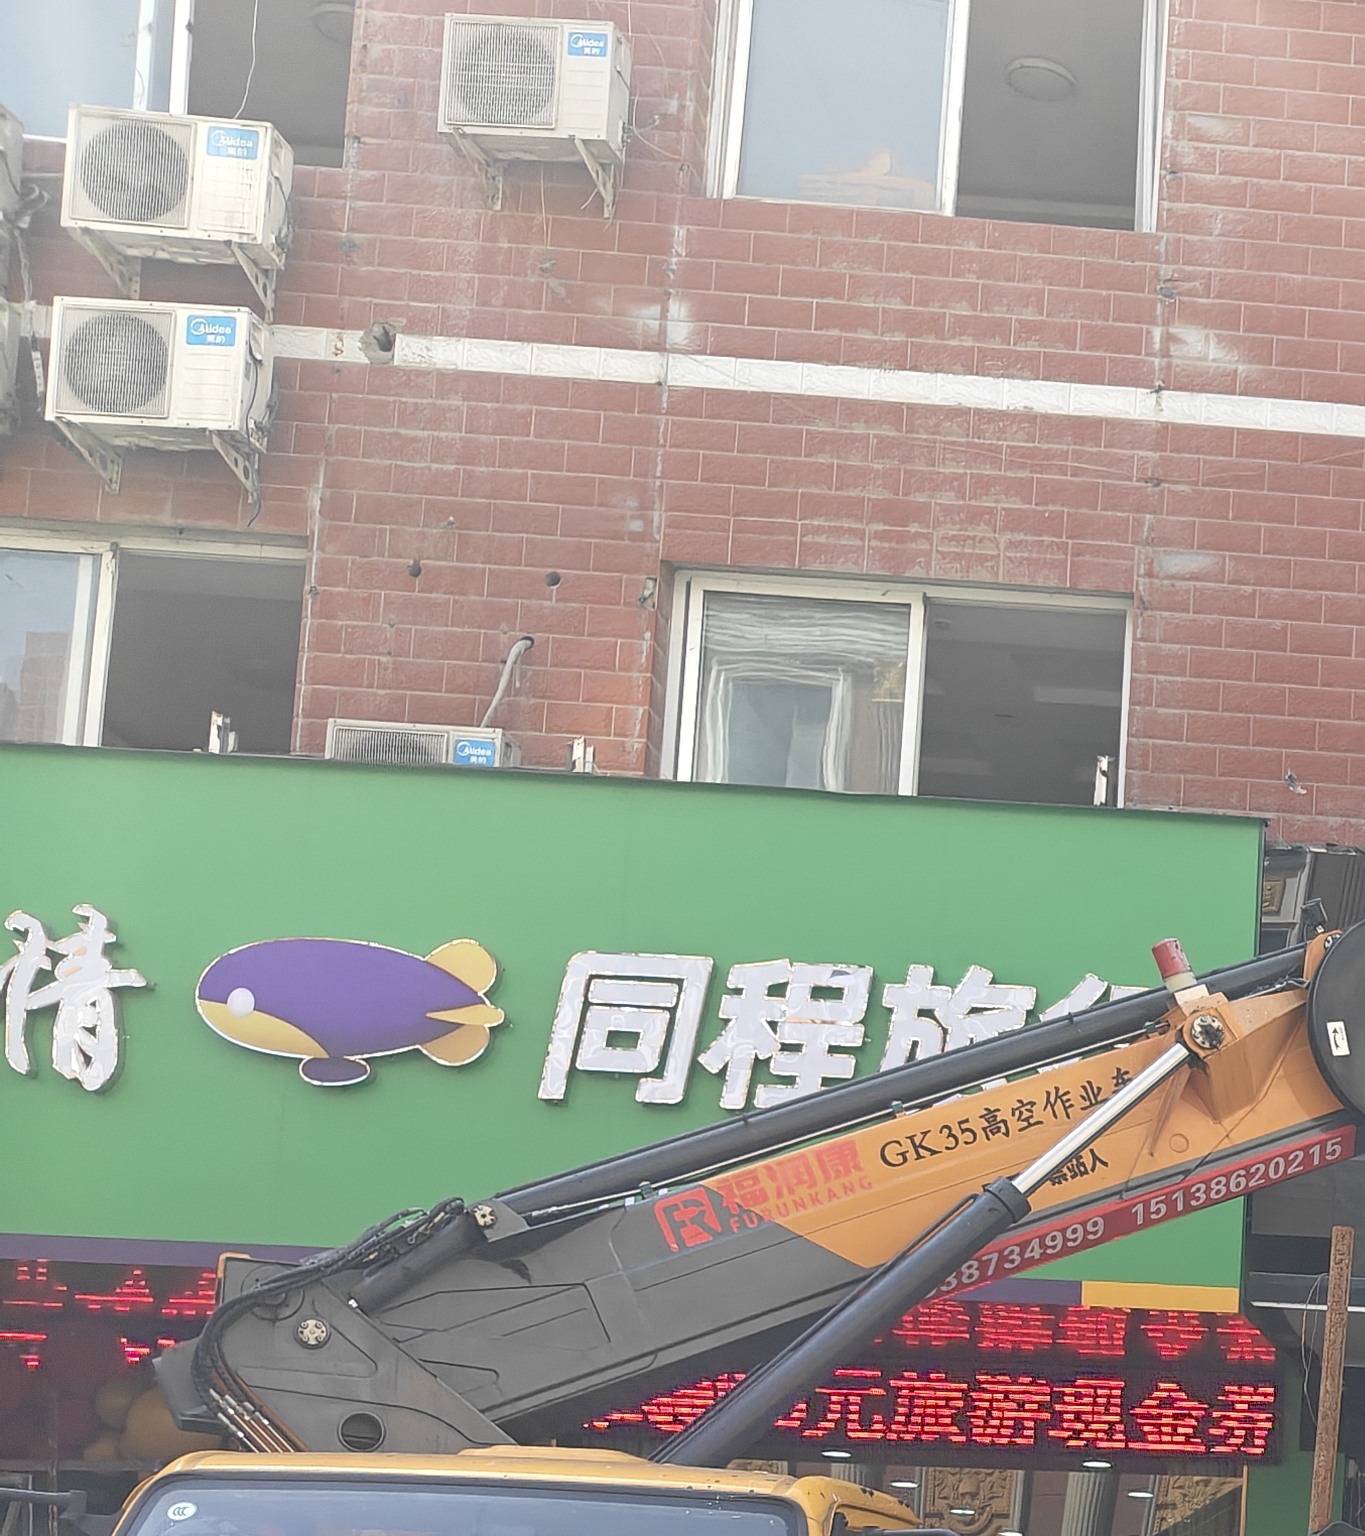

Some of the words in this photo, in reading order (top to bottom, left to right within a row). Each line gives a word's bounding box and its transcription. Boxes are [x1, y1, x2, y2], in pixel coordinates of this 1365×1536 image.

[715, 1138, 864, 1215] 福润康
[729, 1174, 874, 1233] FURUNKANG
[1130, 1136, 1343, 1226] 15138620215
